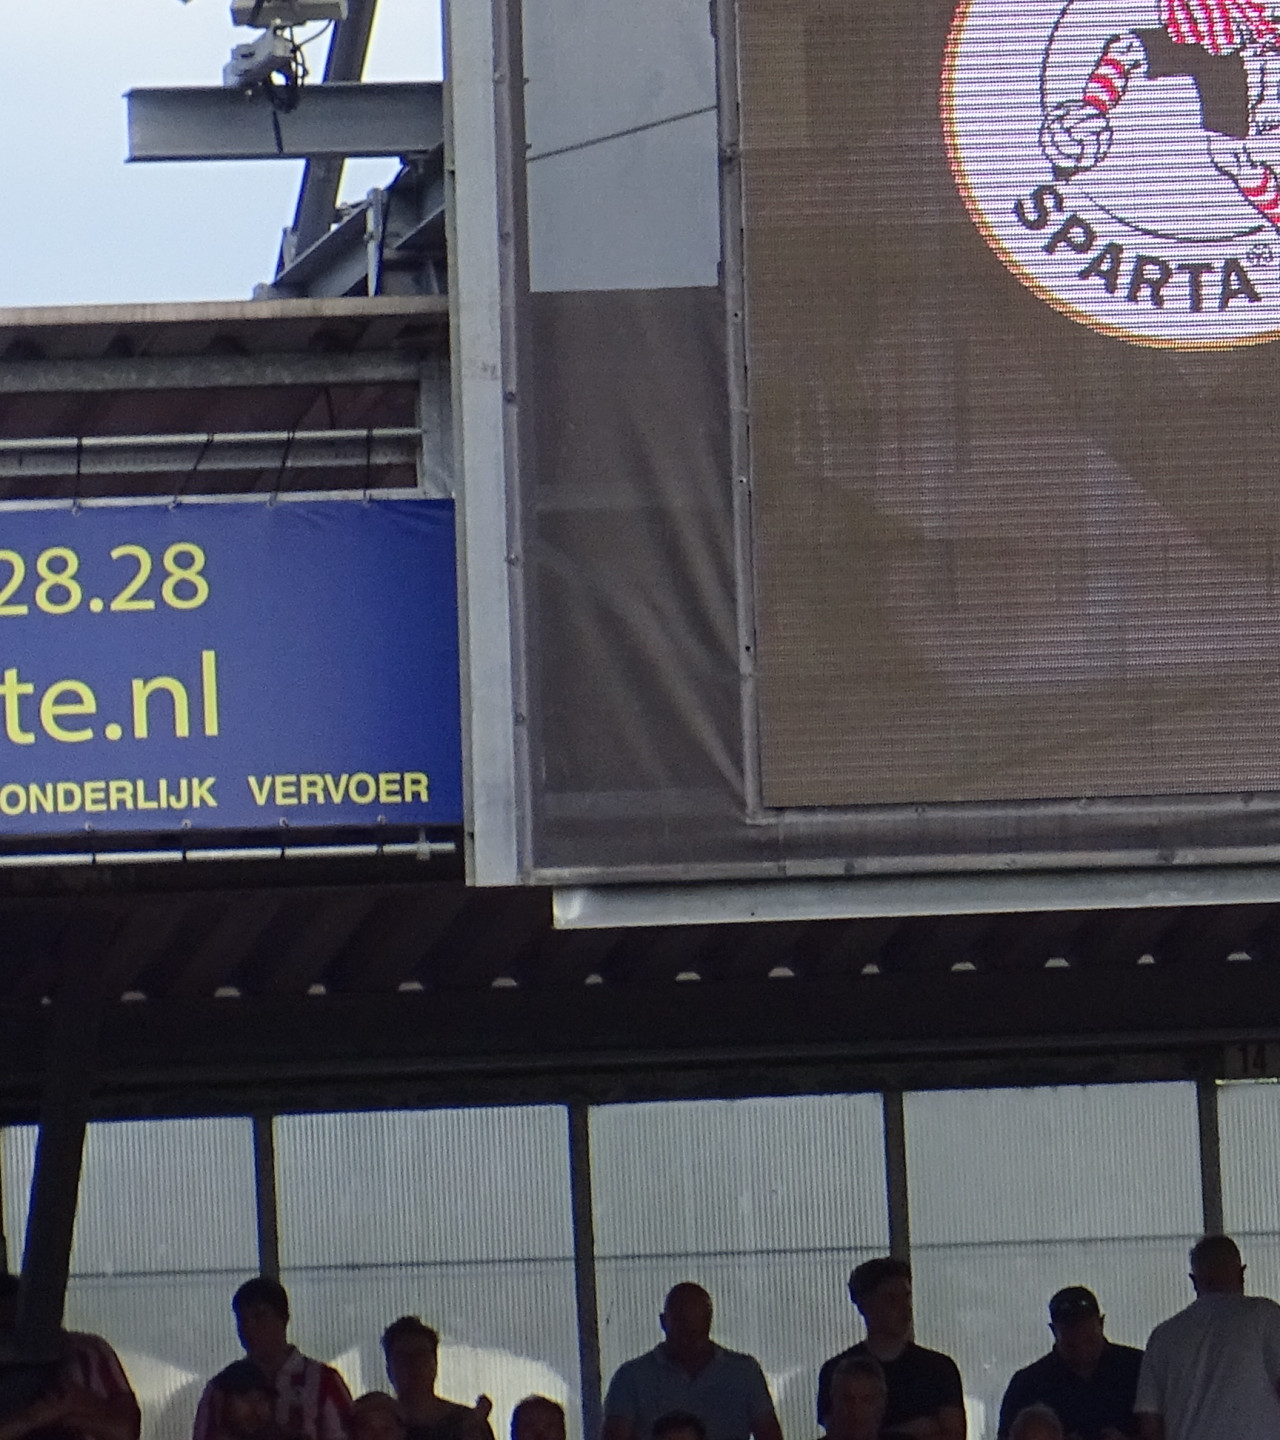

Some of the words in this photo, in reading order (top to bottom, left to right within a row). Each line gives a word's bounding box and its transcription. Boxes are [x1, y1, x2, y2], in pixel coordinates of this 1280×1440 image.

[1012, 183, 1263, 314] SPARTA
[0, 649, 220, 744] te.nl
[0, 776, 219, 816] ONDERLIJK
[247, 771, 430, 807] VERVOER
